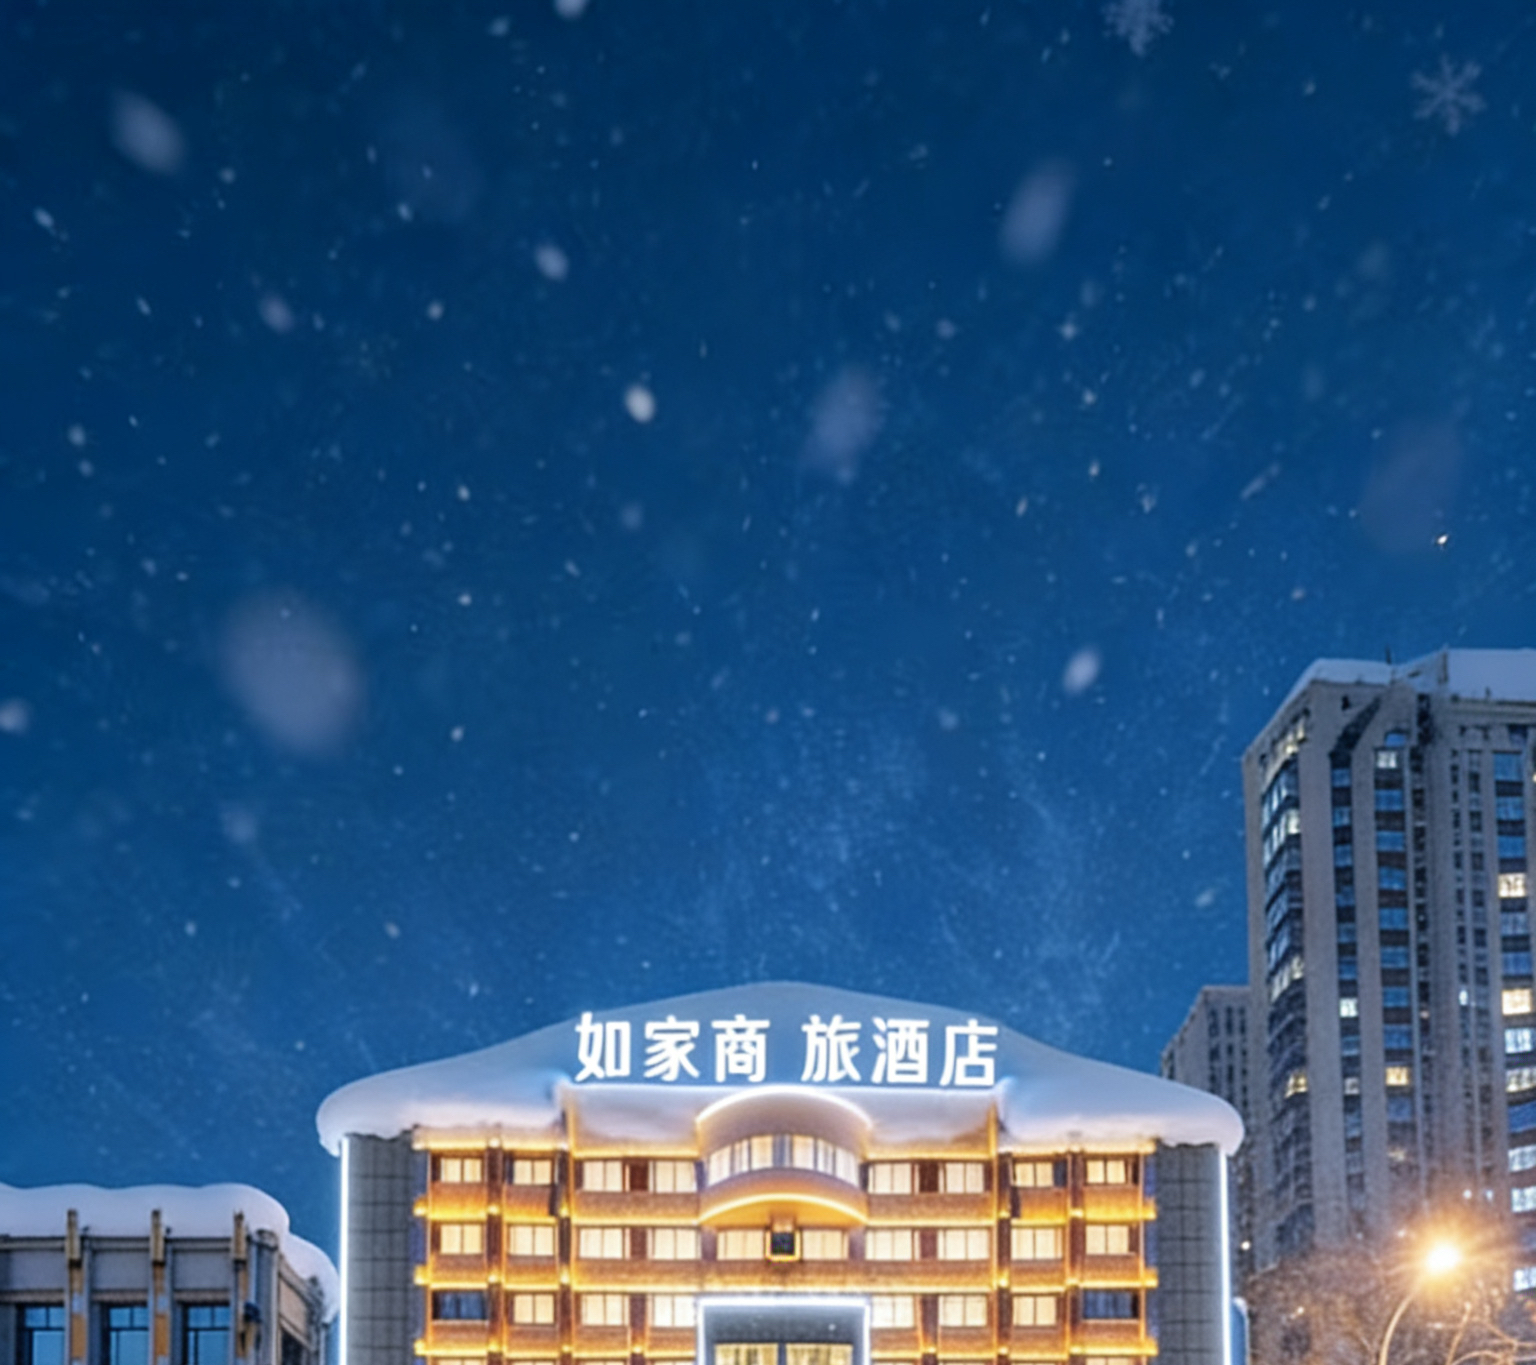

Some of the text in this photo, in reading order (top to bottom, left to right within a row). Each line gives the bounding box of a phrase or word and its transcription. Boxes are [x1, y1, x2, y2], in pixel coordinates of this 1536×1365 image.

[574, 1011, 999, 1087] 如家商旅酒店
